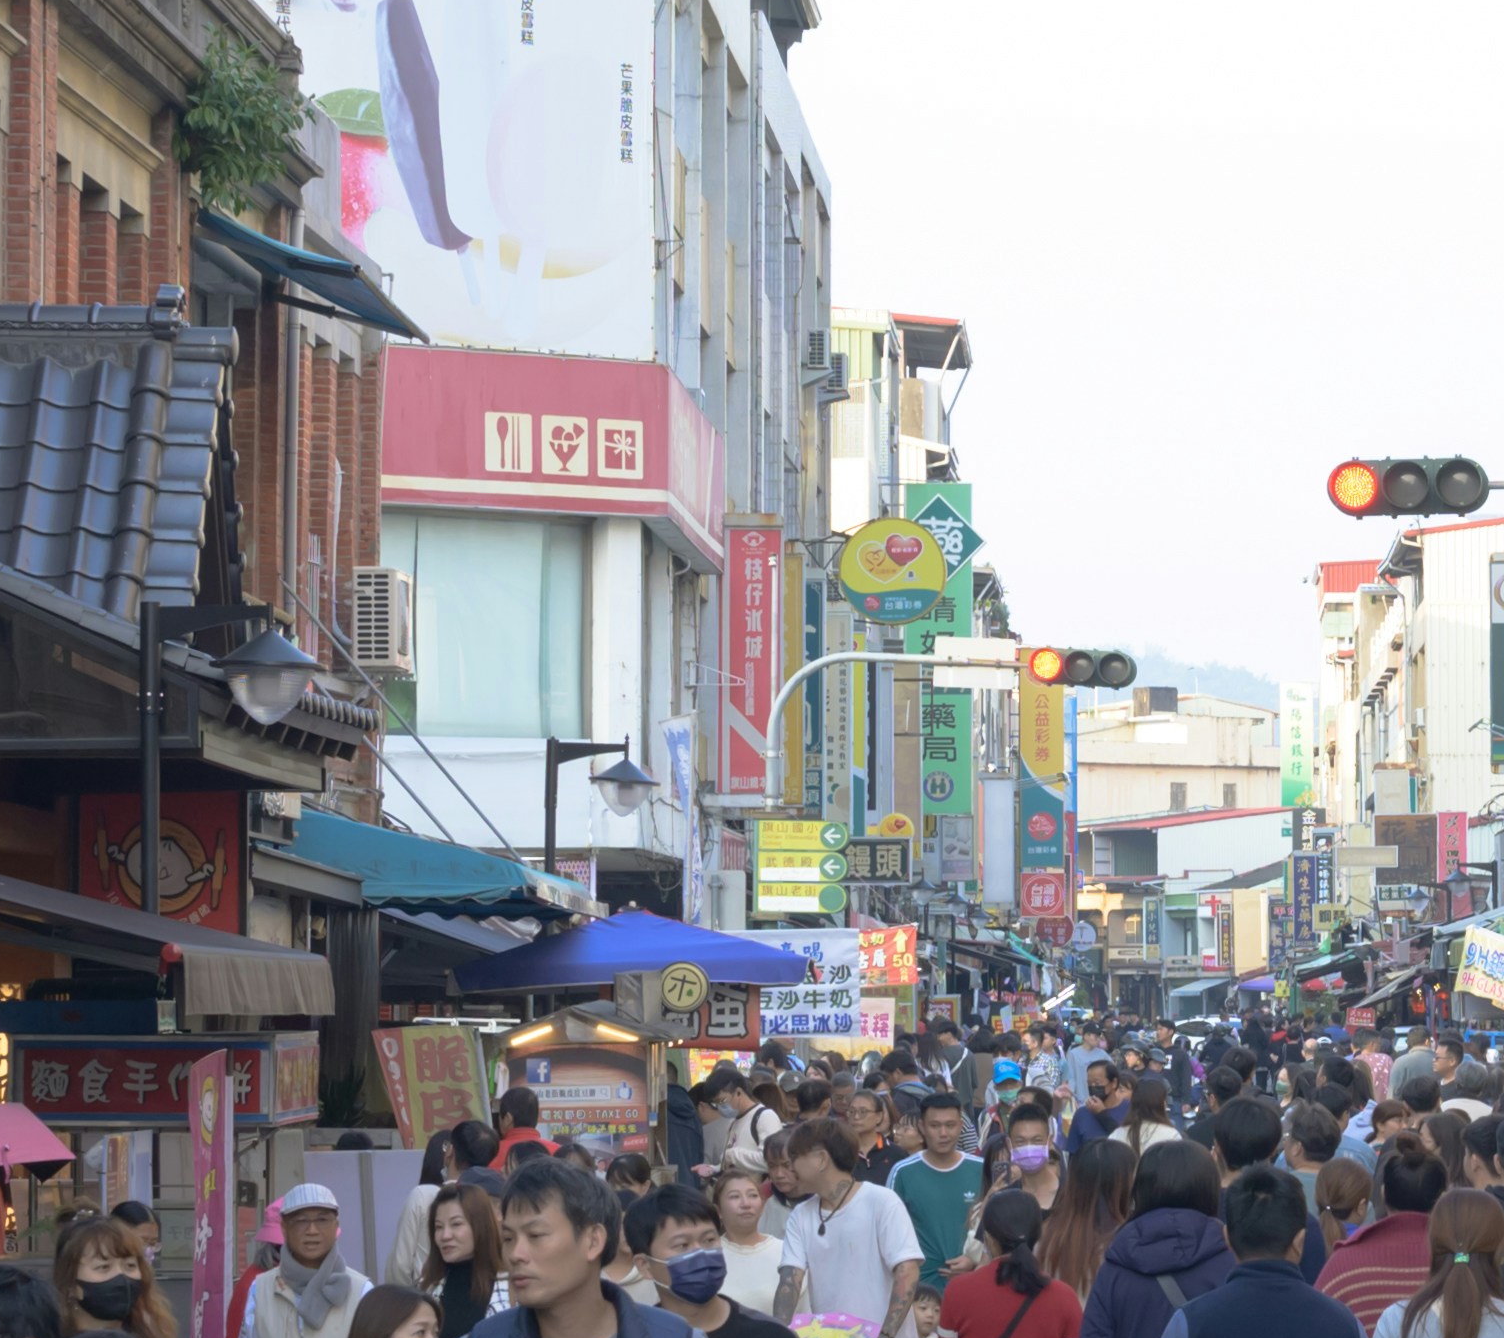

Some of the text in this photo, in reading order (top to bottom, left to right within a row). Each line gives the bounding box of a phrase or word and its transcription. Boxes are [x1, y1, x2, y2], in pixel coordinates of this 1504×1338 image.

[1035, 694, 1049, 761] 公益彩券
[845, 844, 902, 878] 饅頭
[893, 954, 913, 967] 50
[1461, 973, 1475, 985] 9H
[413, 1035, 473, 1132] 脆皮
